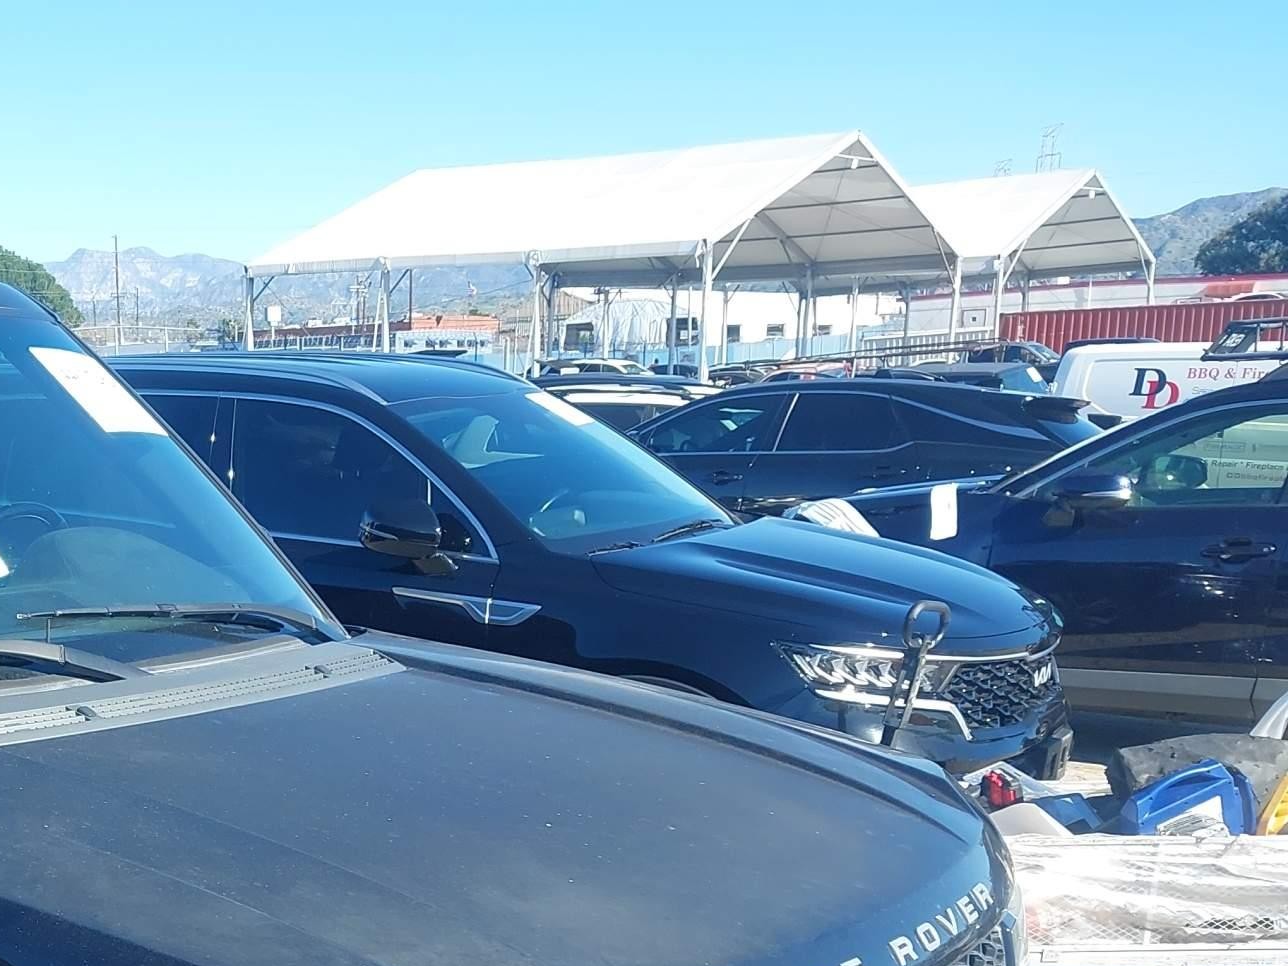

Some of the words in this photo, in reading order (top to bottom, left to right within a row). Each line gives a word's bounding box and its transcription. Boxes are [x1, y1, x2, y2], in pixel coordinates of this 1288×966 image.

[1187, 368, 1219, 380] BBQ
[1224, 368, 1236, 379] &
[1241, 368, 1269, 379] Fir
[1211, 460, 1239, 468] Repair
[887, 881, 994, 966] ROVER
